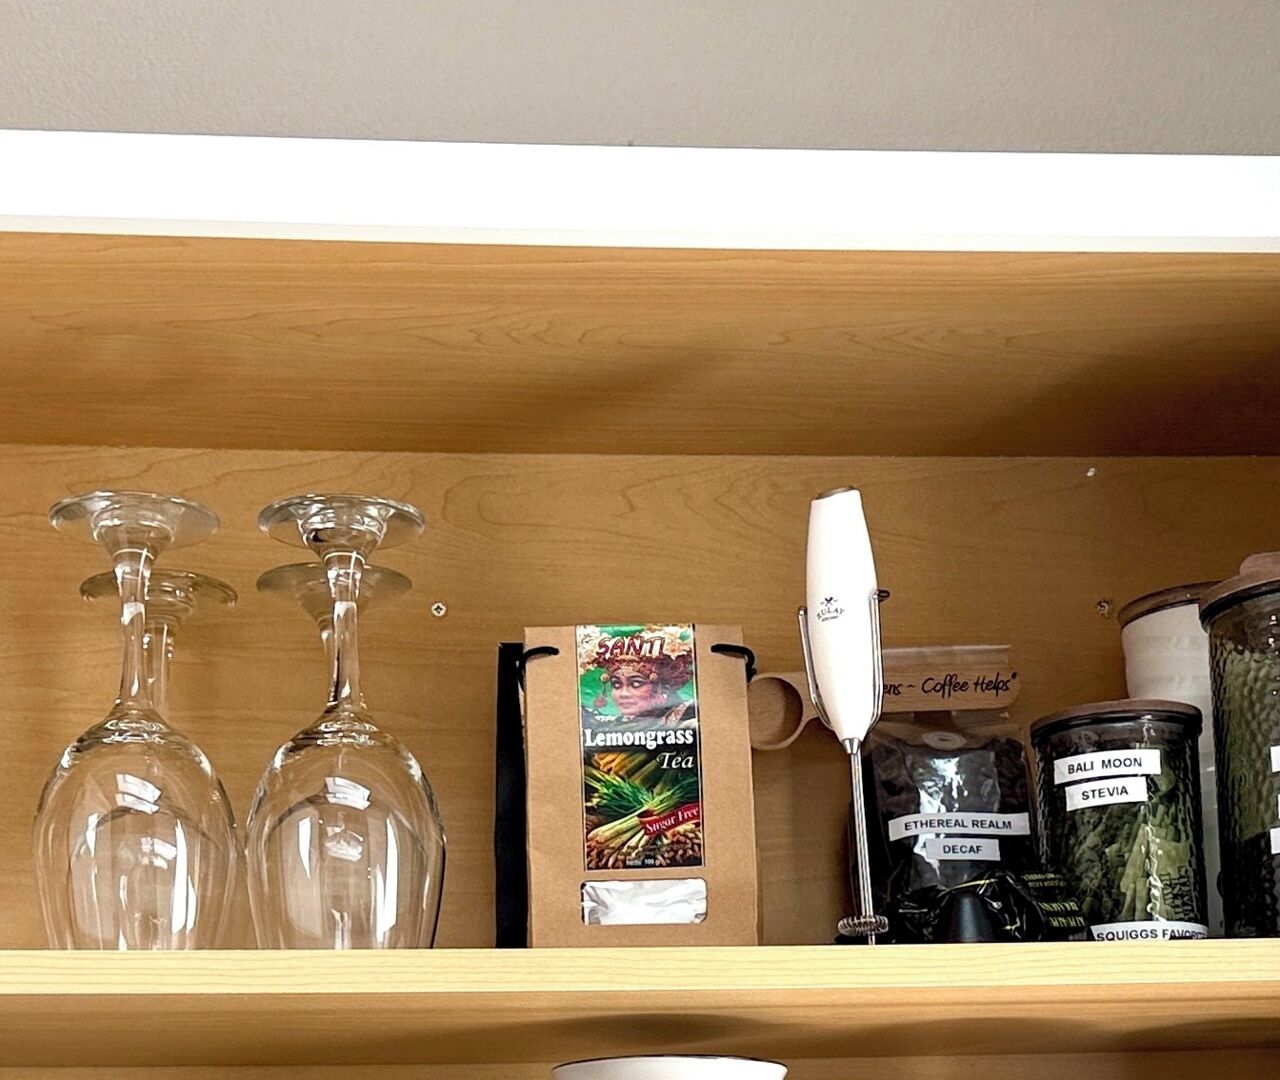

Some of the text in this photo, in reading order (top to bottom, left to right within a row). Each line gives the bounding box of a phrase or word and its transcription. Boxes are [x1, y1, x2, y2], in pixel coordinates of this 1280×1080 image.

[921, 673, 970, 699] Coffee
[584, 728, 694, 749] Lemongrass
[656, 750, 695, 770] Tea
[1067, 757, 1143, 775] BALI MOON
[1081, 785, 1129, 801] STEVIA
[644, 806, 700, 835] Sugar Free
[904, 818, 1012, 831] ETHEREAL REALM
[942, 844, 983, 855] DECAF
[1096, 928, 1160, 941] SQUIGGS
